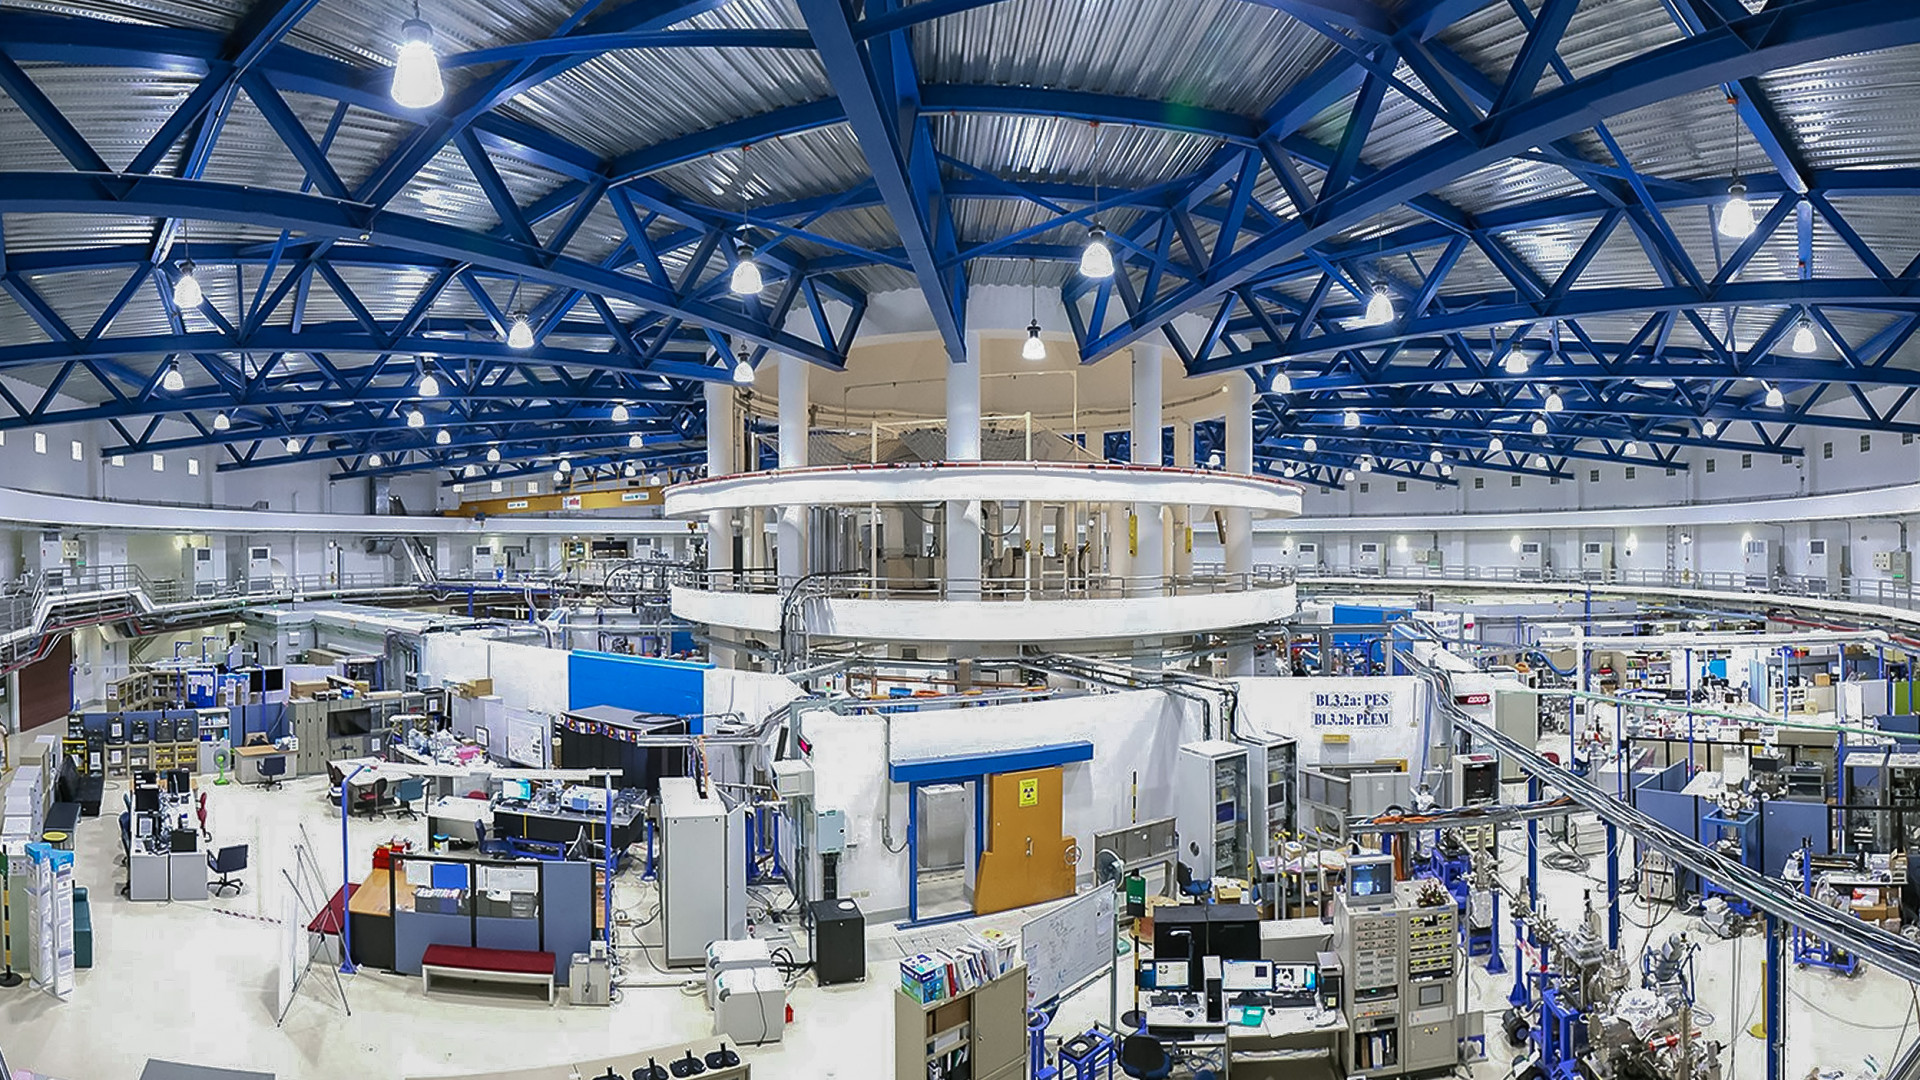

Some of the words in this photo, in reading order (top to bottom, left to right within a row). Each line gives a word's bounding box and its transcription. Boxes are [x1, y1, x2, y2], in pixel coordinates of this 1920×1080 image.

[1316, 694, 1361, 706] BL3.2a:
[1364, 693, 1389, 706] PES
[1314, 713, 1354, 725] BL3.2b:
[1356, 713, 1389, 725] PEEM
